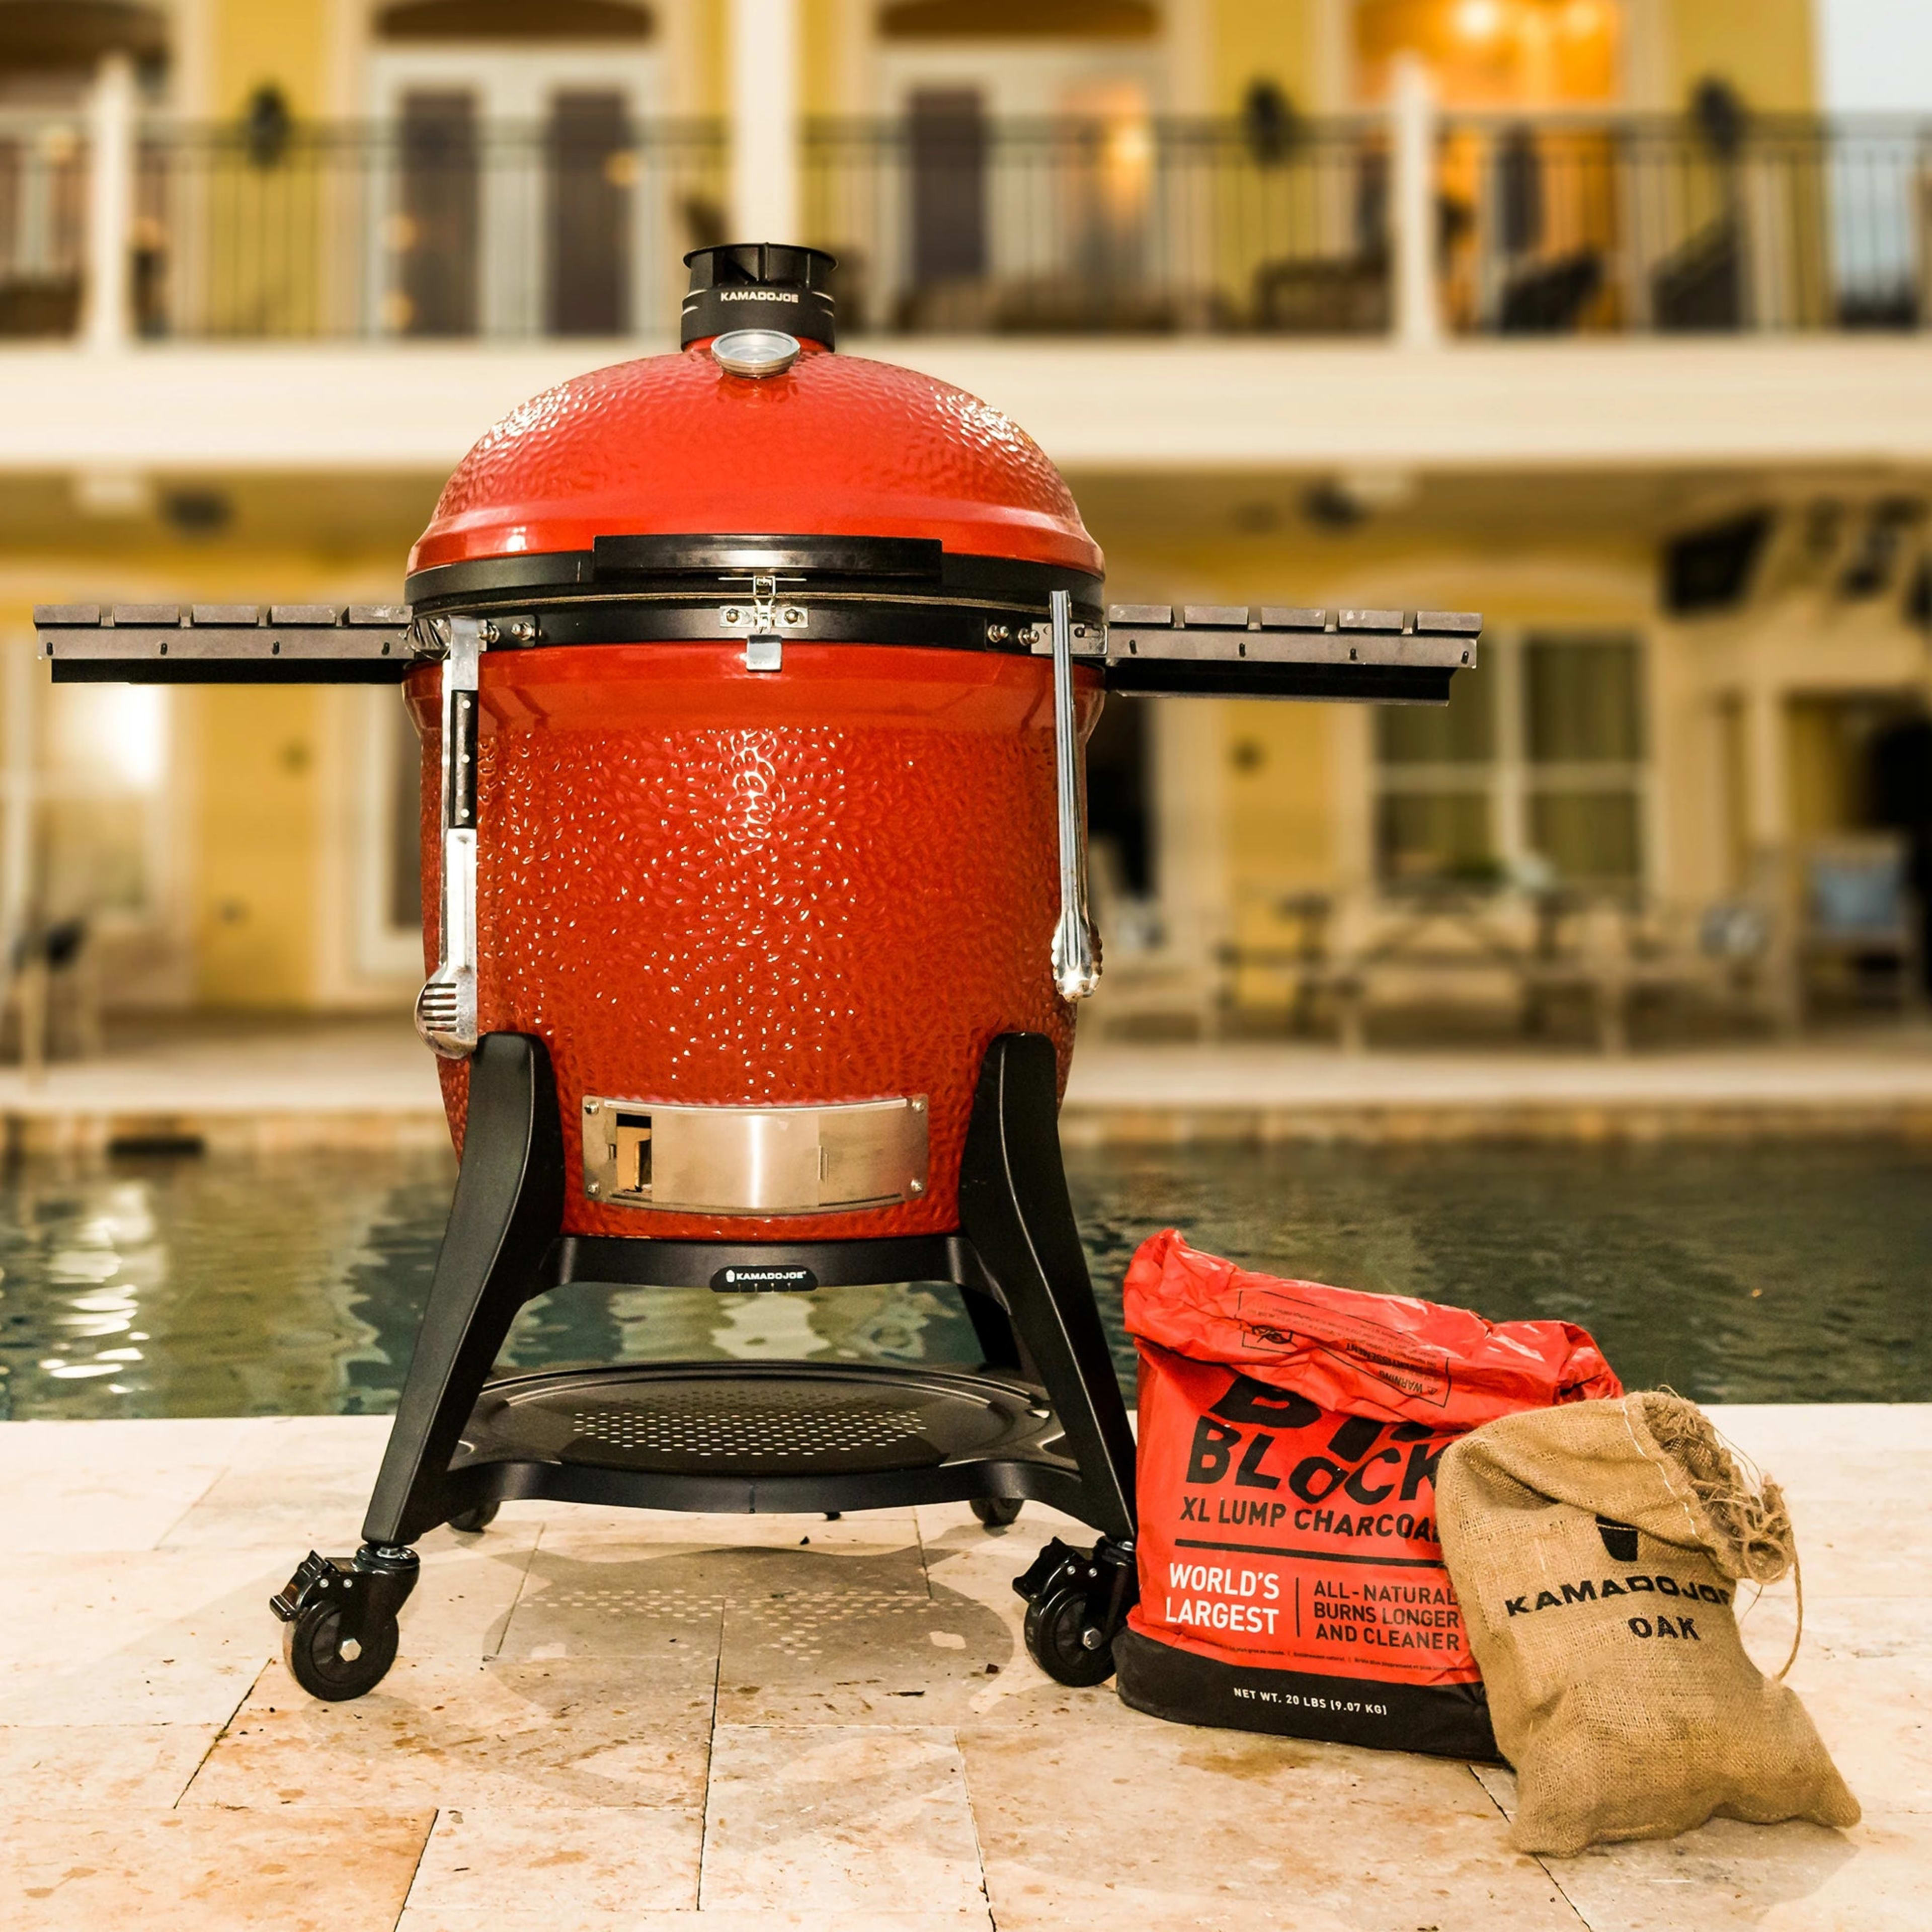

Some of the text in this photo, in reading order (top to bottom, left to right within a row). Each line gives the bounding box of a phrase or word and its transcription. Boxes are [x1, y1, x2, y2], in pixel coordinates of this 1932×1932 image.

[720, 291, 799, 303] KAMADOJOE
[736, 1272, 803, 1280] KAMADOJOE
[1186, 1415, 1452, 1504] BLOCK
[1180, 1496, 1210, 1522] XL
[1219, 1498, 1286, 1527] LUMP
[1170, 1563, 1280, 1599] WORLD'S
[1165, 1596, 1279, 1635] LARGEST
[1314, 1602, 1460, 1628] BURNS LONGER
[1628, 1615, 1701, 1641] OAK
[1316, 1623, 1460, 1651] AND CLEANER
[1234, 1687, 1387, 1715] NET WT. 20 LBS (9.07 KG)
